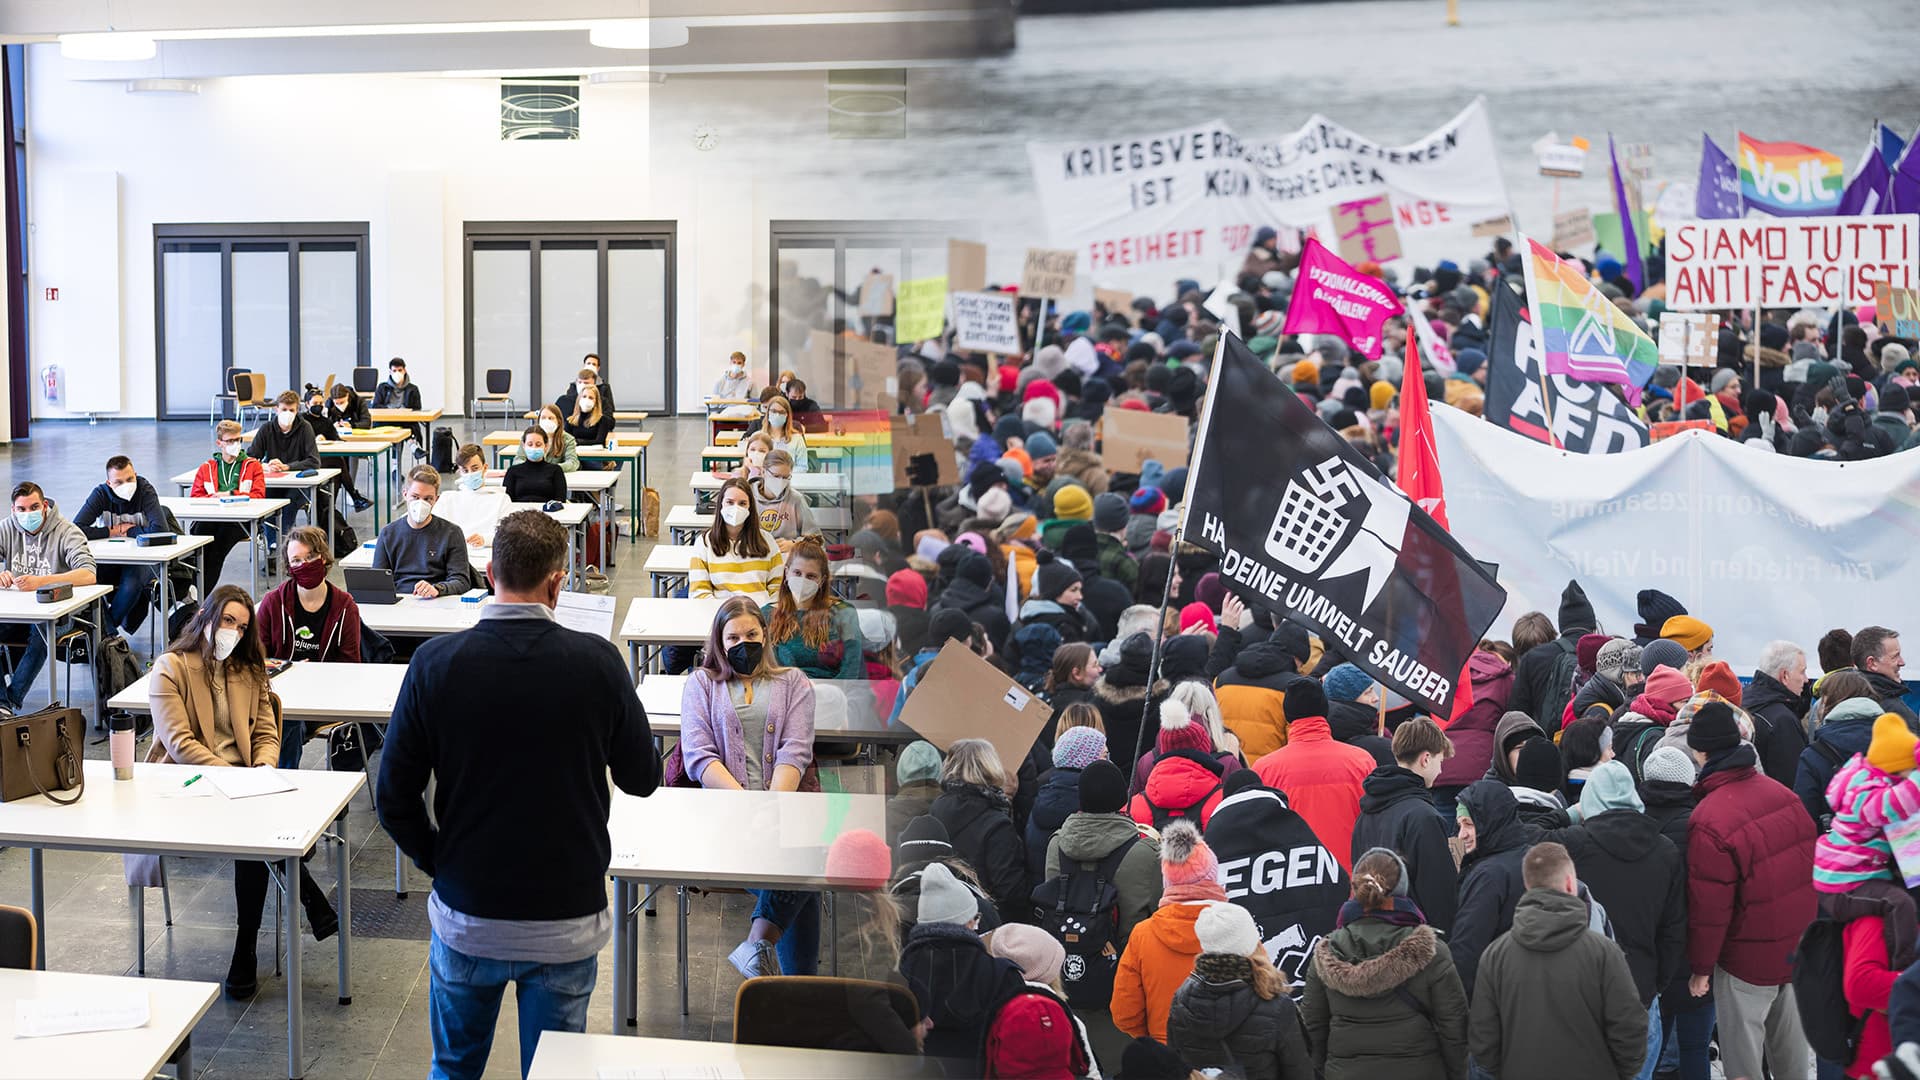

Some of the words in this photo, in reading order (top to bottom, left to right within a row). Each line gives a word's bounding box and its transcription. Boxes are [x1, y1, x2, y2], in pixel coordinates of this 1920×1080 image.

[1131, 177, 1174, 209] IST
[1746, 150, 1836, 203] Volt
[1090, 229, 1206, 270] FREIHEIT
[1398, 200, 1451, 227] NGE
[1671, 225, 1787, 262] SIAMO
[1799, 224, 1908, 262] TUTTI
[1511, 377, 1643, 455] AFD
[1201, 511, 1226, 554] HA
[1222, 548, 1288, 600] DEINE
[1285, 585, 1374, 652] UMWELT
[1367, 640, 1451, 705] SAUBER
[1218, 845, 1340, 900] EGEN
